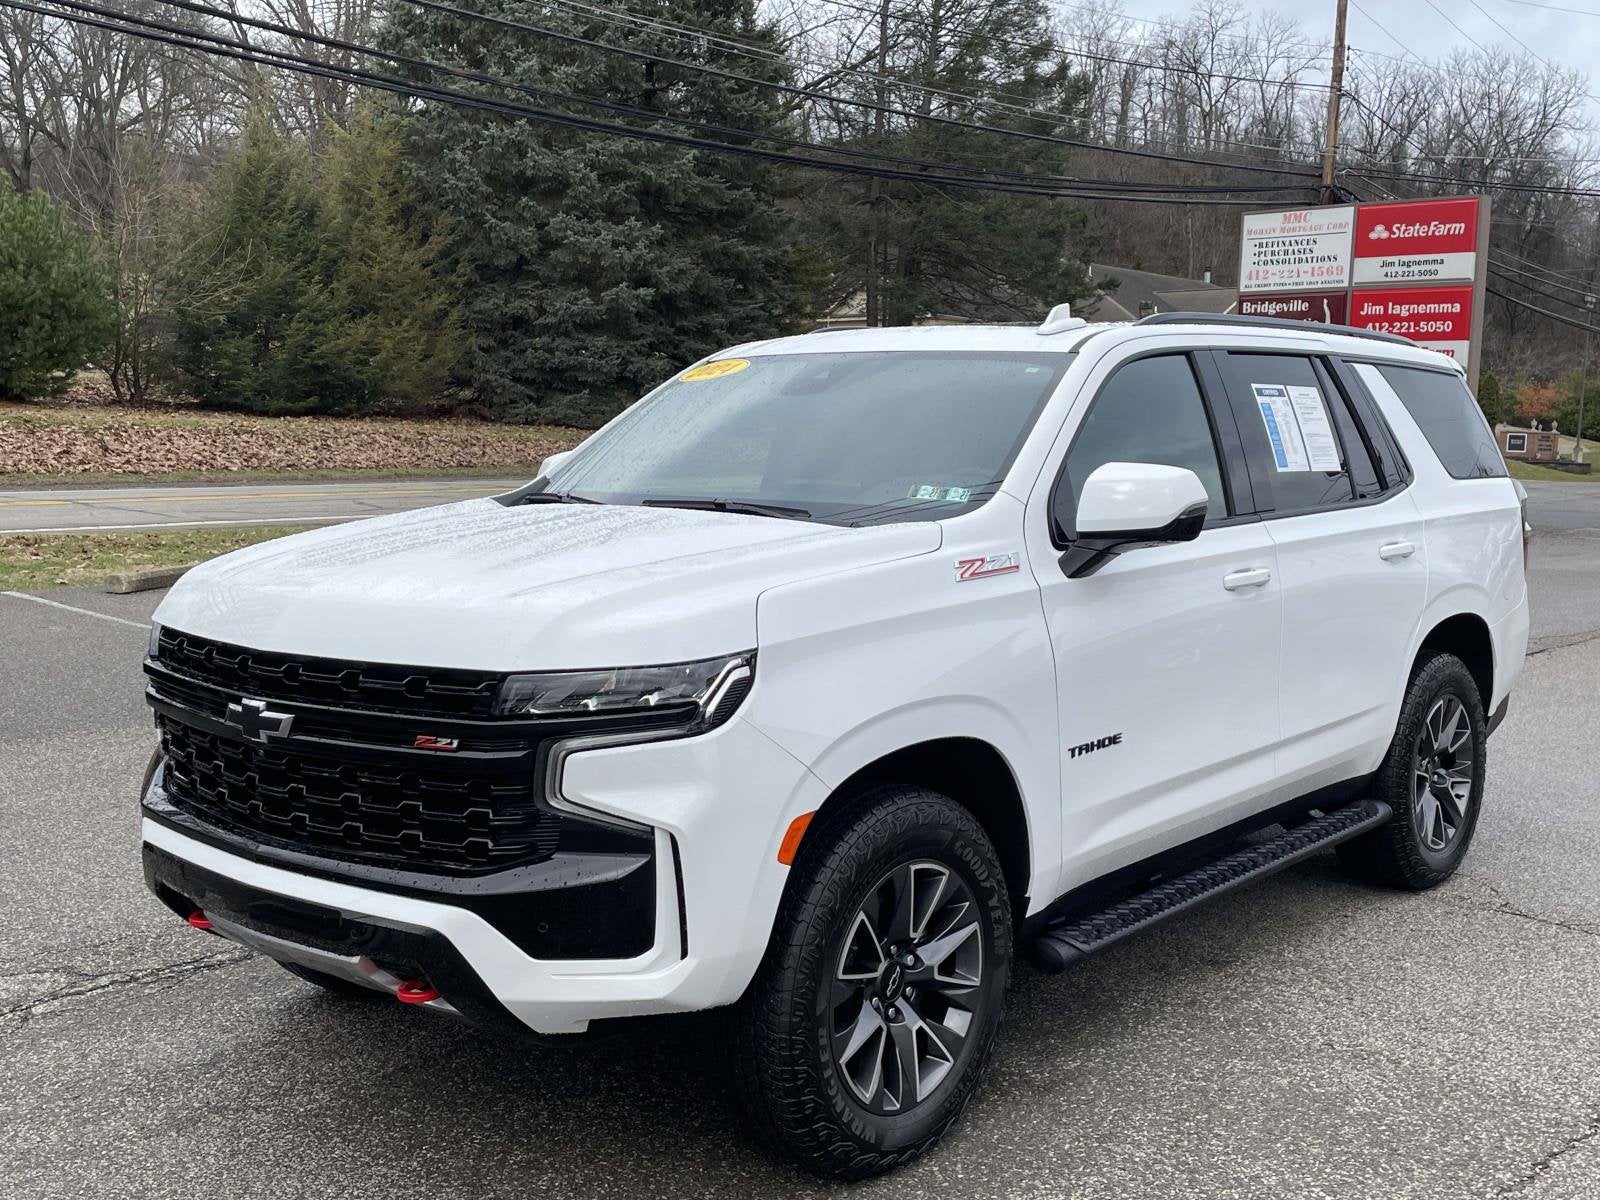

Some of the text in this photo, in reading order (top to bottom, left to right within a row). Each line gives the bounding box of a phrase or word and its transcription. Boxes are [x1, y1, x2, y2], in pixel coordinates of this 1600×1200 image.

[1282, 212, 1312, 224] MMC
[1280, 224, 1325, 234] MORTGAGE
[1258, 238, 1318, 249] REFINANCES
[1257, 247, 1314, 258] PURCHASES
[1257, 255, 1338, 267] CONSOLIDATIONS
[1380, 260, 1396, 268] Jim
[1247, 265, 1344, 281] 412-221-1569
[1384, 269, 1439, 278] 412-221-5050
[1242, 299, 1309, 315] Bridgeville
[1360, 302, 1461, 317] Jim Iagnemma
[1366, 320, 1453, 333] 412-221-5050
[954, 552, 1020, 582] Z71
[415, 735, 459, 751] Z71
[1067, 732, 1123, 759] TAHOE
